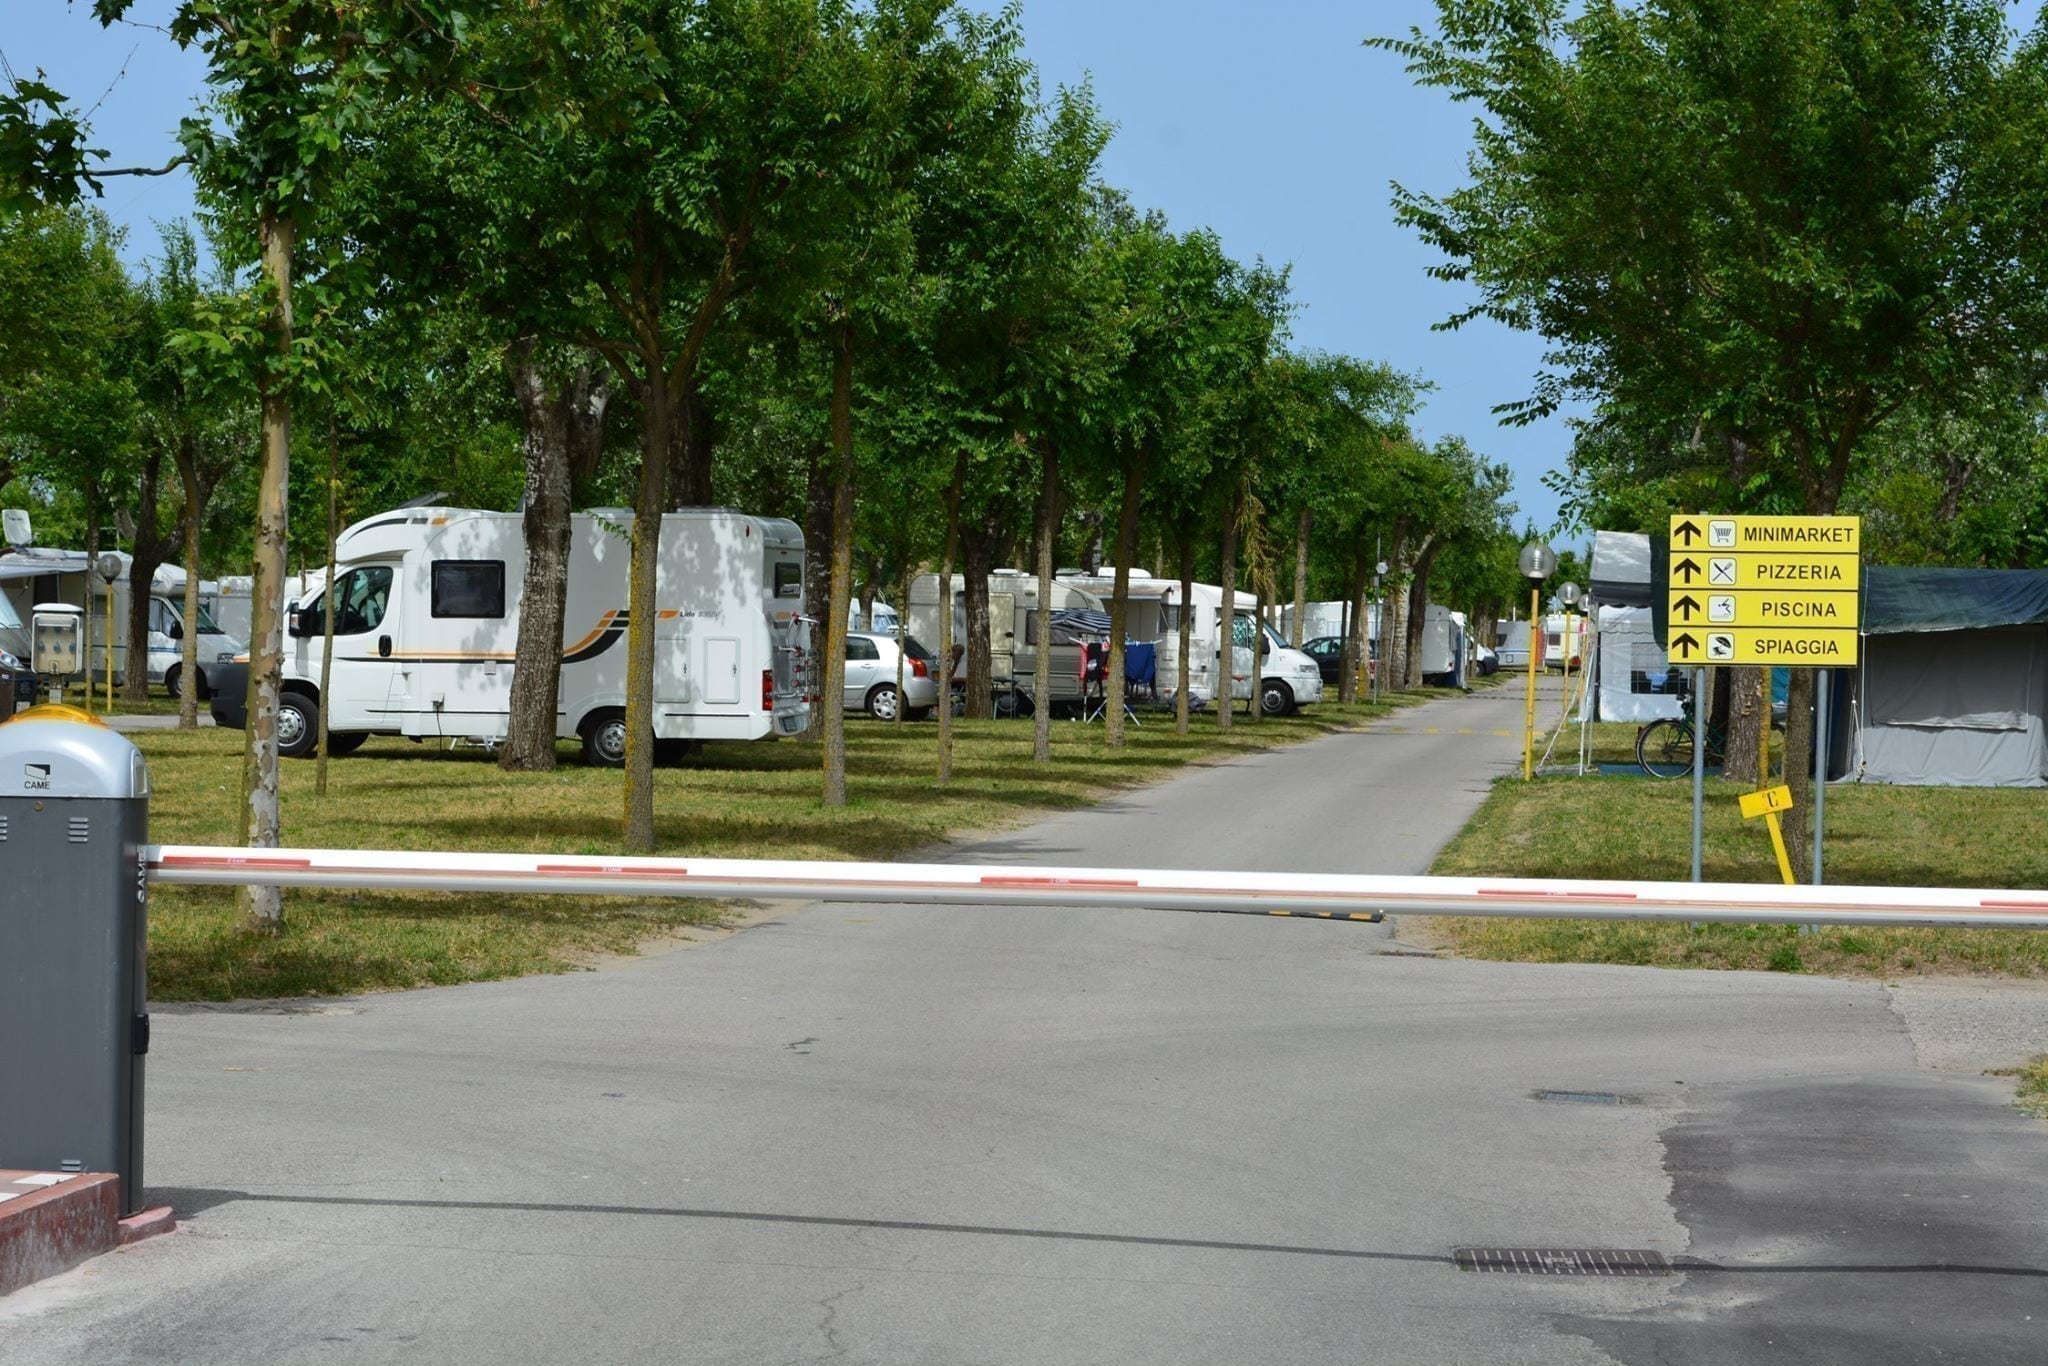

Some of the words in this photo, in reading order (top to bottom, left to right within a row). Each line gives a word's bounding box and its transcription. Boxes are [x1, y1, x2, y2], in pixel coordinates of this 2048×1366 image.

[1744, 527, 1854, 542] MINIMARKET
[1757, 564, 1842, 580] PIZZERIA
[1762, 602, 1837, 617] PISCINA
[1755, 639, 1839, 655] SPIAGGIA
[24, 780, 51, 790] CAME
